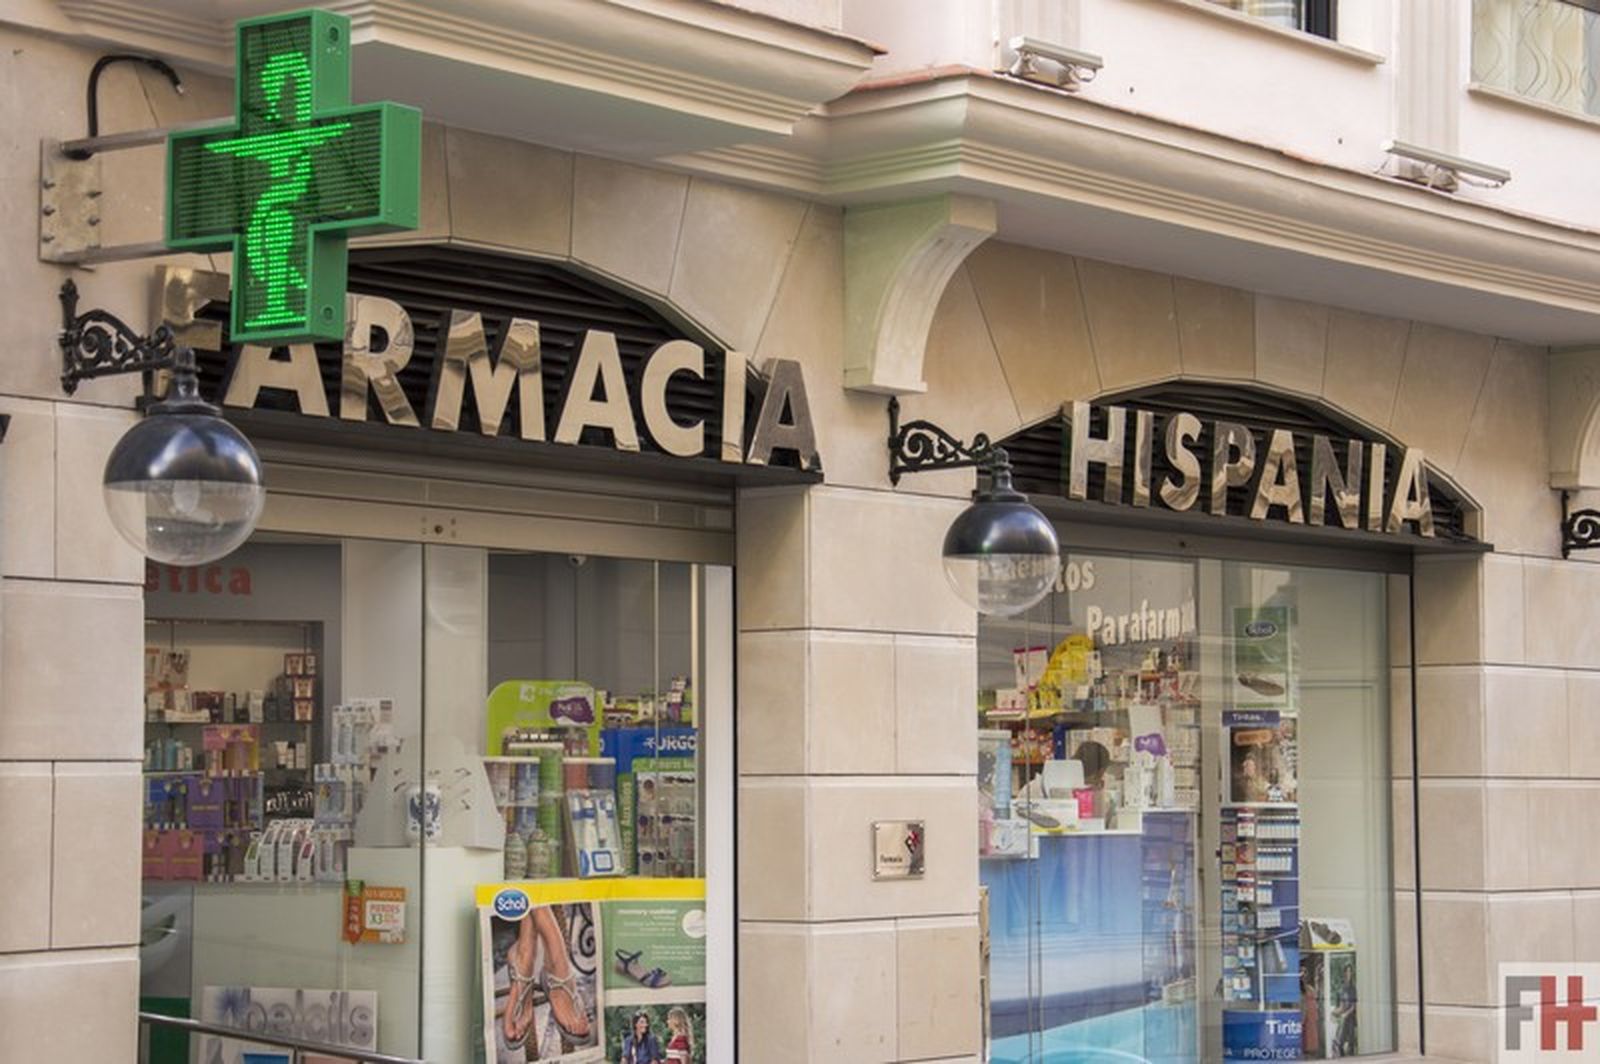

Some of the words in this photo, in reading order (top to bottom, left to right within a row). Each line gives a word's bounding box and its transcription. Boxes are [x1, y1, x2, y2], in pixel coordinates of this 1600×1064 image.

[152, 265, 823, 472] FARMACIA
[1062, 399, 1437, 539] HISPANIA
[497, 895, 527, 911] Scholl
